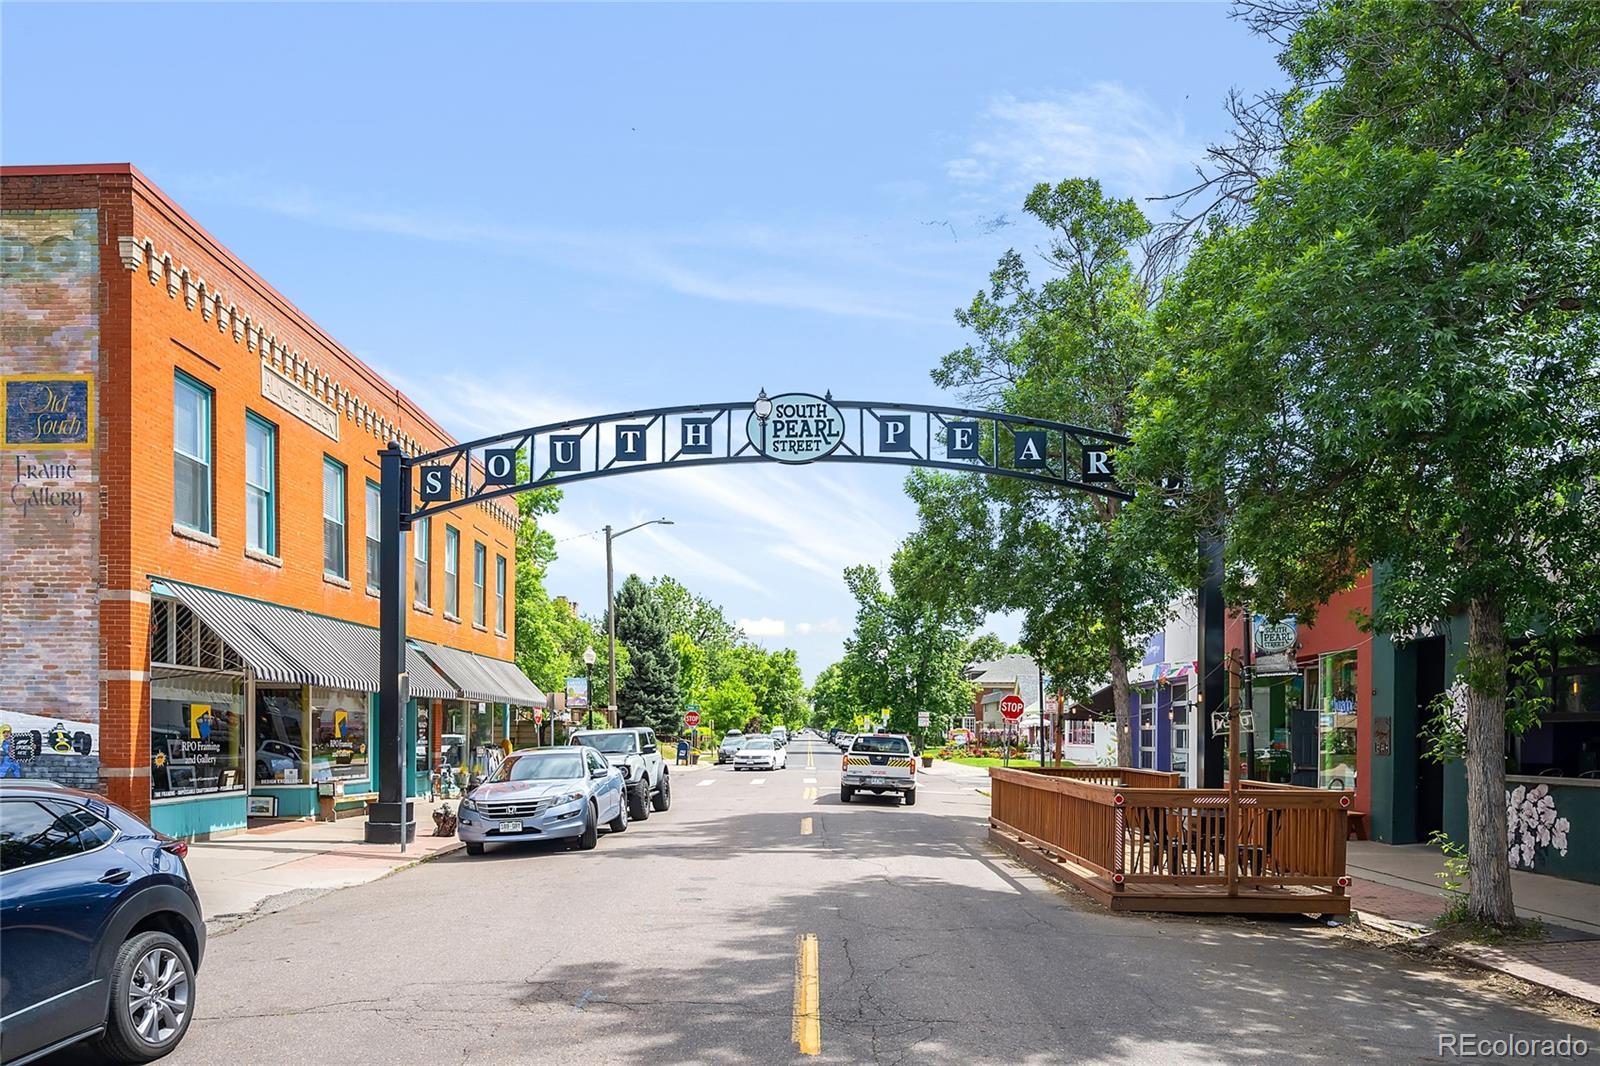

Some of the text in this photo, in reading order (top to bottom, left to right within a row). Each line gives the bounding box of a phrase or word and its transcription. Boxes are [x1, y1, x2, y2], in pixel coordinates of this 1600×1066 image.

[20, 385, 69, 413] Old
[776, 404, 827, 418] SOUTH
[33, 413, 81, 441] South
[772, 418, 839, 445] PEARL
[773, 440, 822, 454] STREET
[16, 455, 77, 482] Frame
[425, 423, 708, 495] SOUTH
[11, 483, 83, 517] Gallery
[1263, 632, 1293, 644] PEARL
[1001, 701, 1024, 712] STOP
[182, 741, 220, 752] RPO Framing
[197, 753, 217, 765] Gallery
